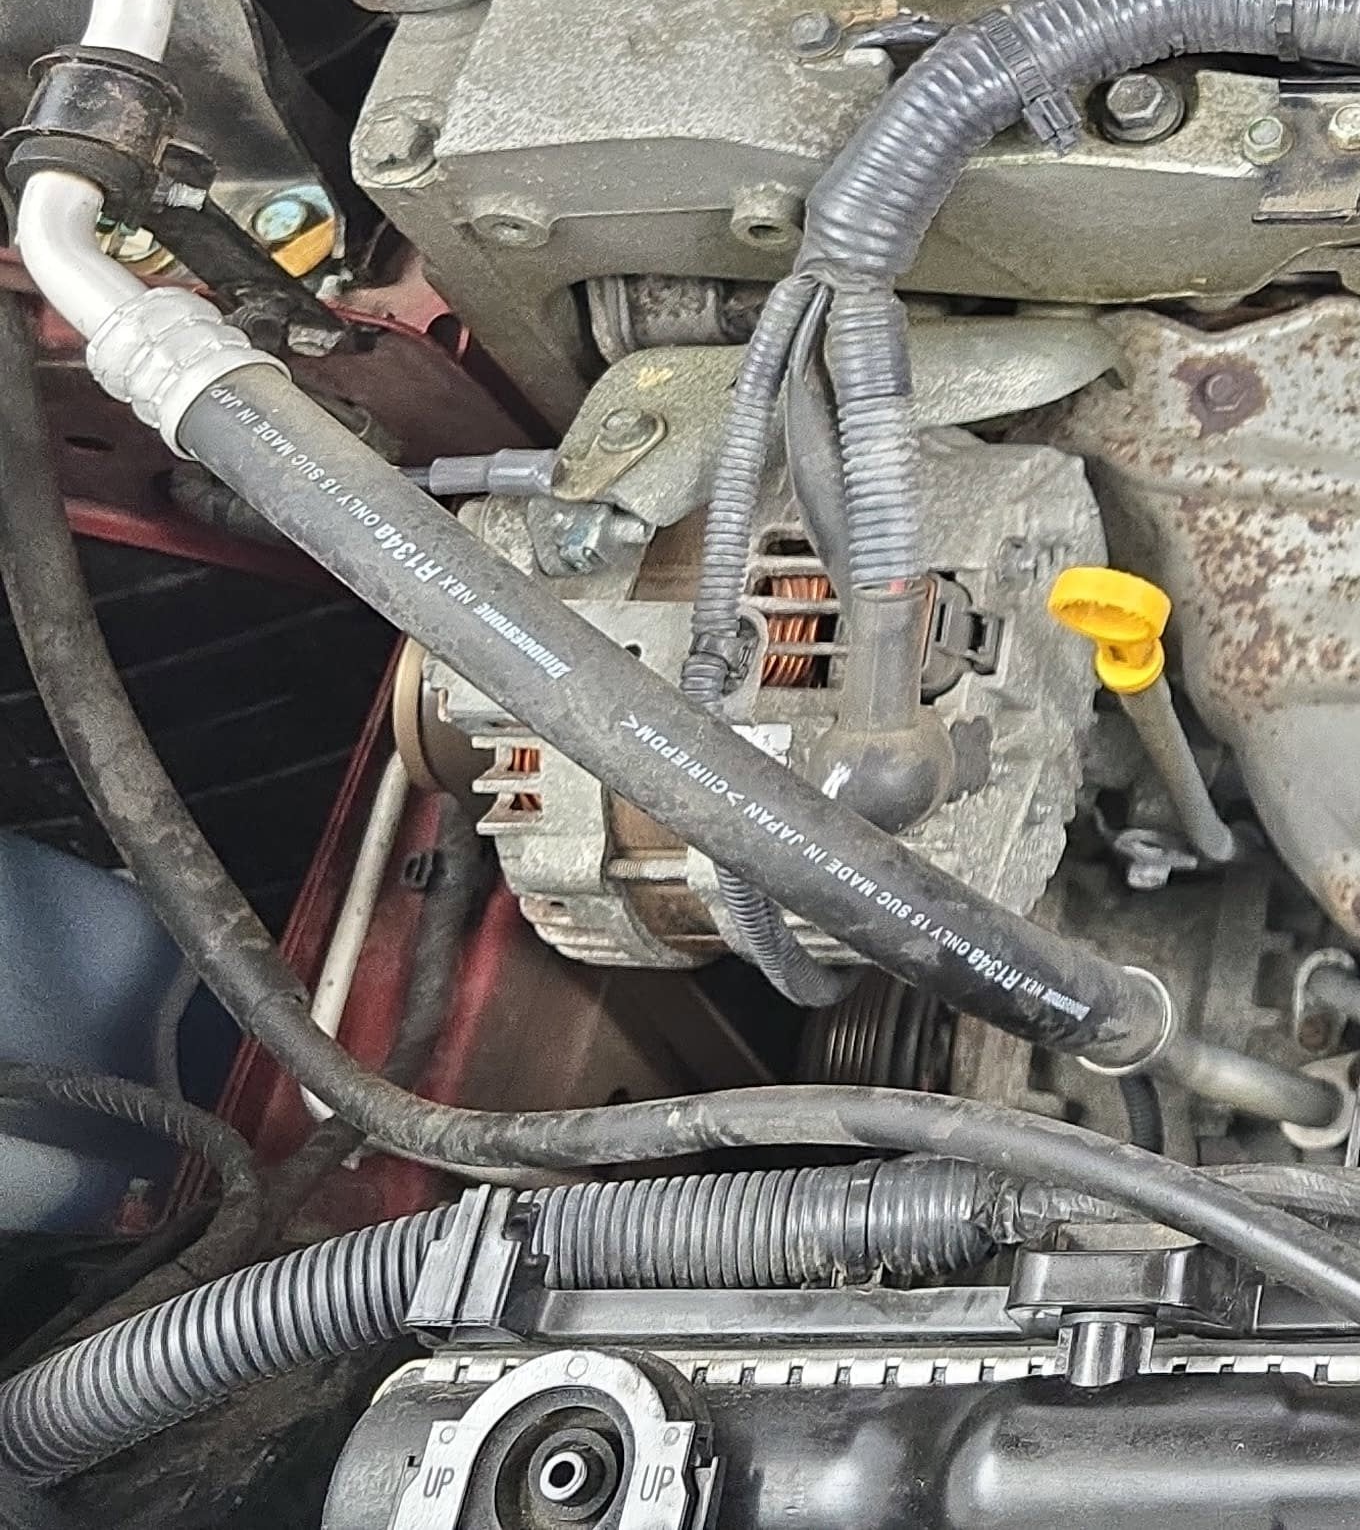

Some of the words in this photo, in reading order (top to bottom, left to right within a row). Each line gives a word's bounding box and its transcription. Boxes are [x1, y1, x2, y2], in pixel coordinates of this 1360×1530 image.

[236, 404, 260, 428] IN
[251, 417, 297, 459] MADE
[289, 449, 326, 483] SUC
[318, 473, 344, 498] 15
[335, 487, 382, 530] ONLY
[371, 520, 444, 586] R134a
[437, 570, 478, 608] NEX
[741, 798, 808, 850] JAPAN
[802, 840, 829, 866] IN
[824, 855, 878, 899] MADE
[872, 887, 914, 922] SUC
[908, 910, 932, 933] 15
[928, 921, 972, 958] ONLY
[964, 943, 1023, 992] R134a
[1016, 973, 1046, 1001] NEX
[422, 1466, 454, 1498] UP
[639, 1465, 675, 1502] UP
